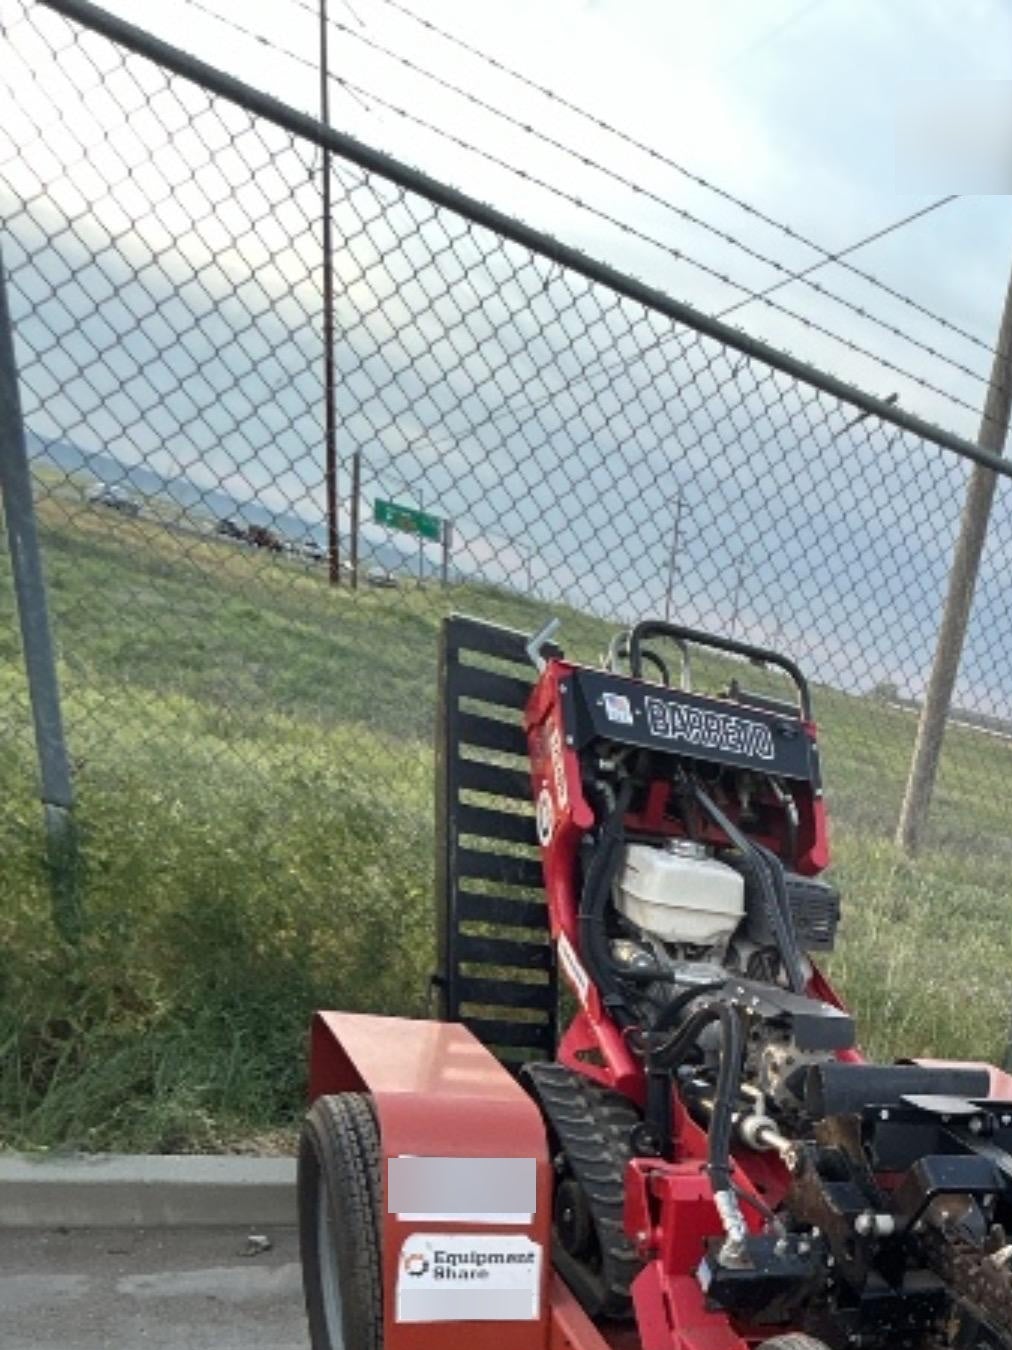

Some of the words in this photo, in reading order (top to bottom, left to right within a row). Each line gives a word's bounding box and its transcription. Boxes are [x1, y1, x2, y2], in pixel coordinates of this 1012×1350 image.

[644, 696, 774, 760] BARRETO
[434, 1250, 535, 1266] Equipment
[433, 1266, 489, 1279] Share
